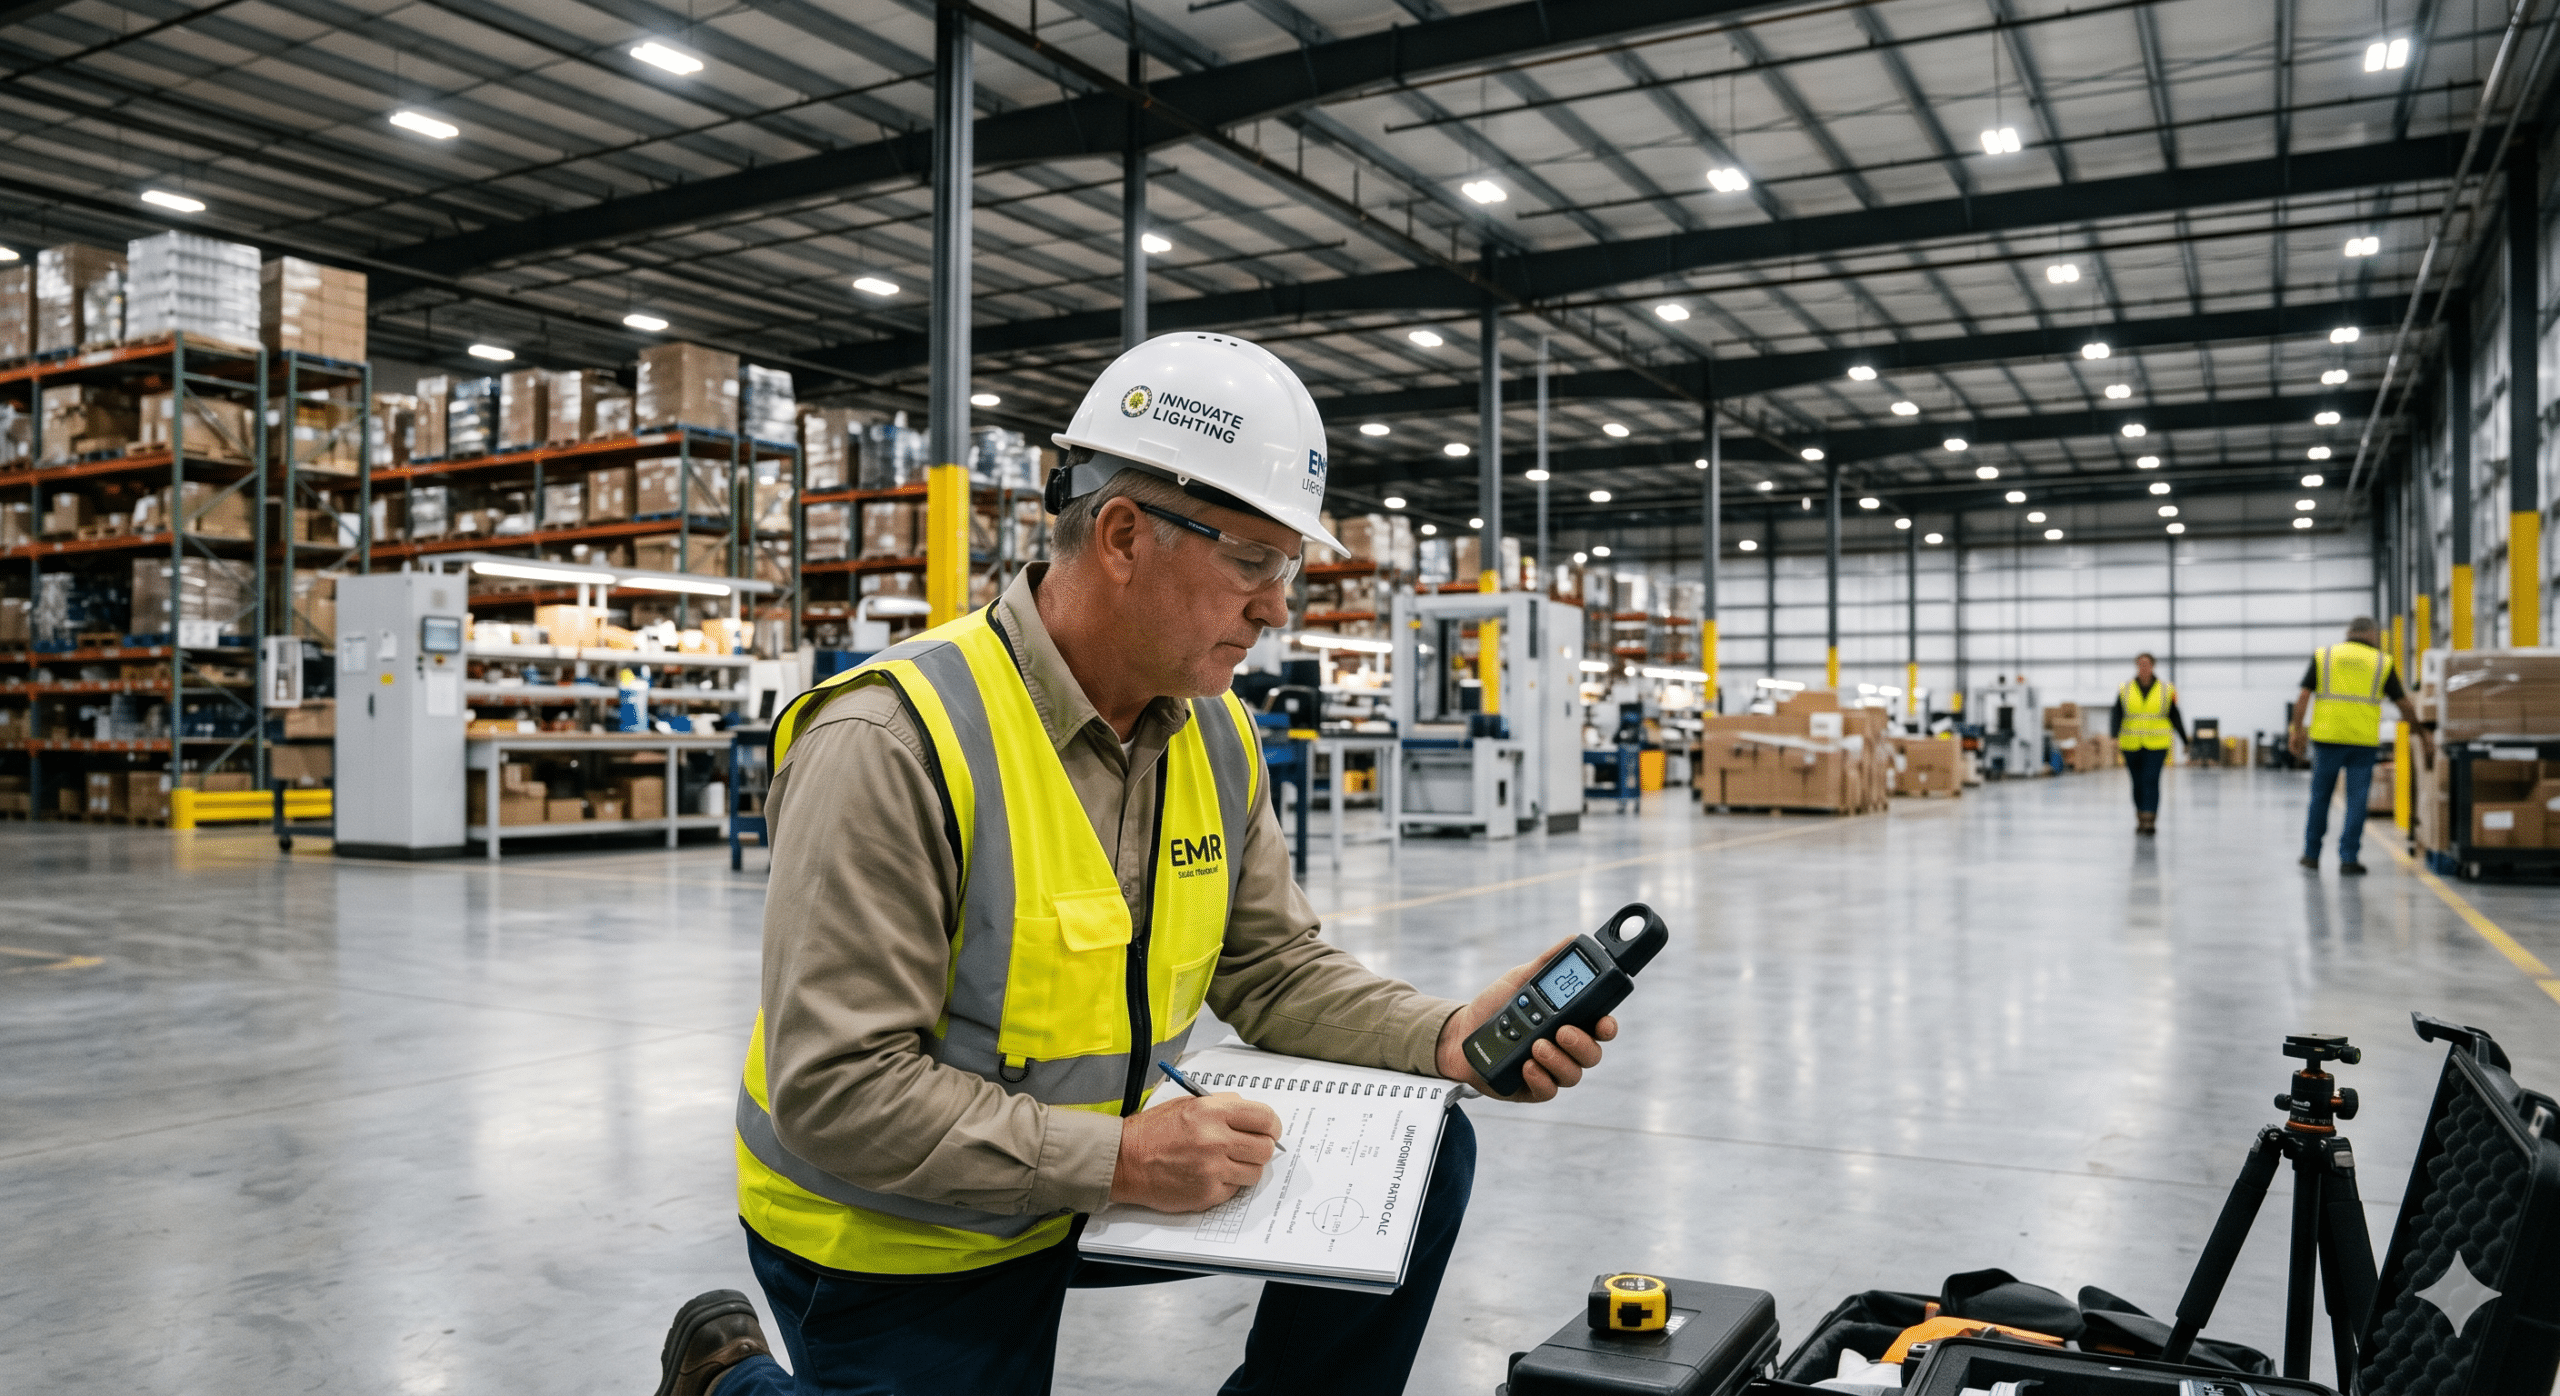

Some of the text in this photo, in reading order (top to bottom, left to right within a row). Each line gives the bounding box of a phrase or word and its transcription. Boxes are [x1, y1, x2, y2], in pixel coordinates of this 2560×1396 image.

[1152, 407, 1236, 444] LIGHTING
[1158, 391, 1244, 430] INNOVATE
[1171, 833, 1223, 867] EMR
[1554, 968, 1584, 998] 285
[1384, 1182, 1401, 1211] RATIO
[1376, 1211, 1392, 1236] CALC
